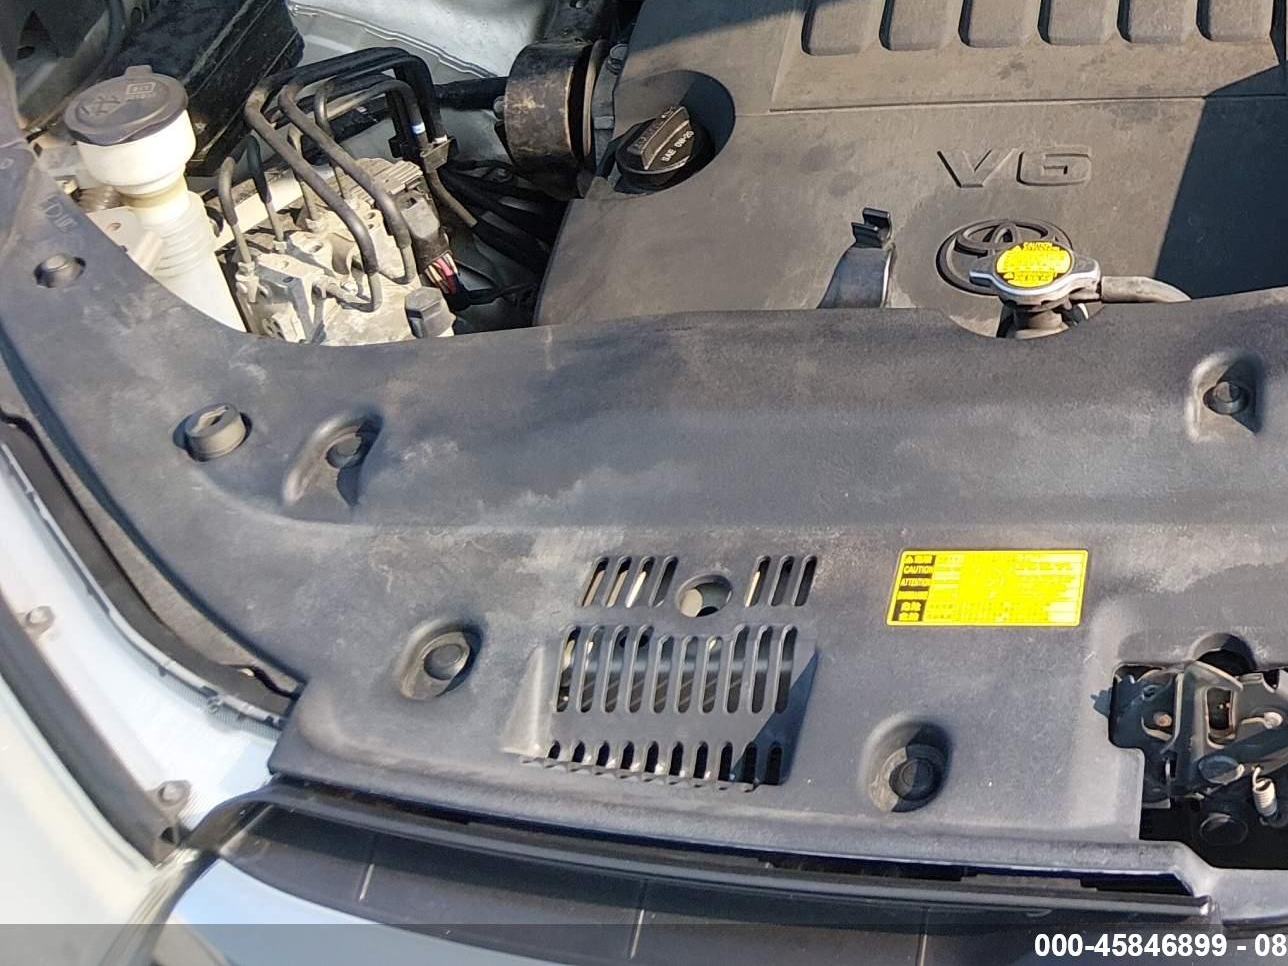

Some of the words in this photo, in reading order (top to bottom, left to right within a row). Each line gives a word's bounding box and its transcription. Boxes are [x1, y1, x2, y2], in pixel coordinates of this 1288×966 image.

[661, 149, 677, 162] SAE
[674, 130, 695, 148] 0W-20
[937, 145, 1092, 188] V6
[903, 565, 934, 575] CAUTION
